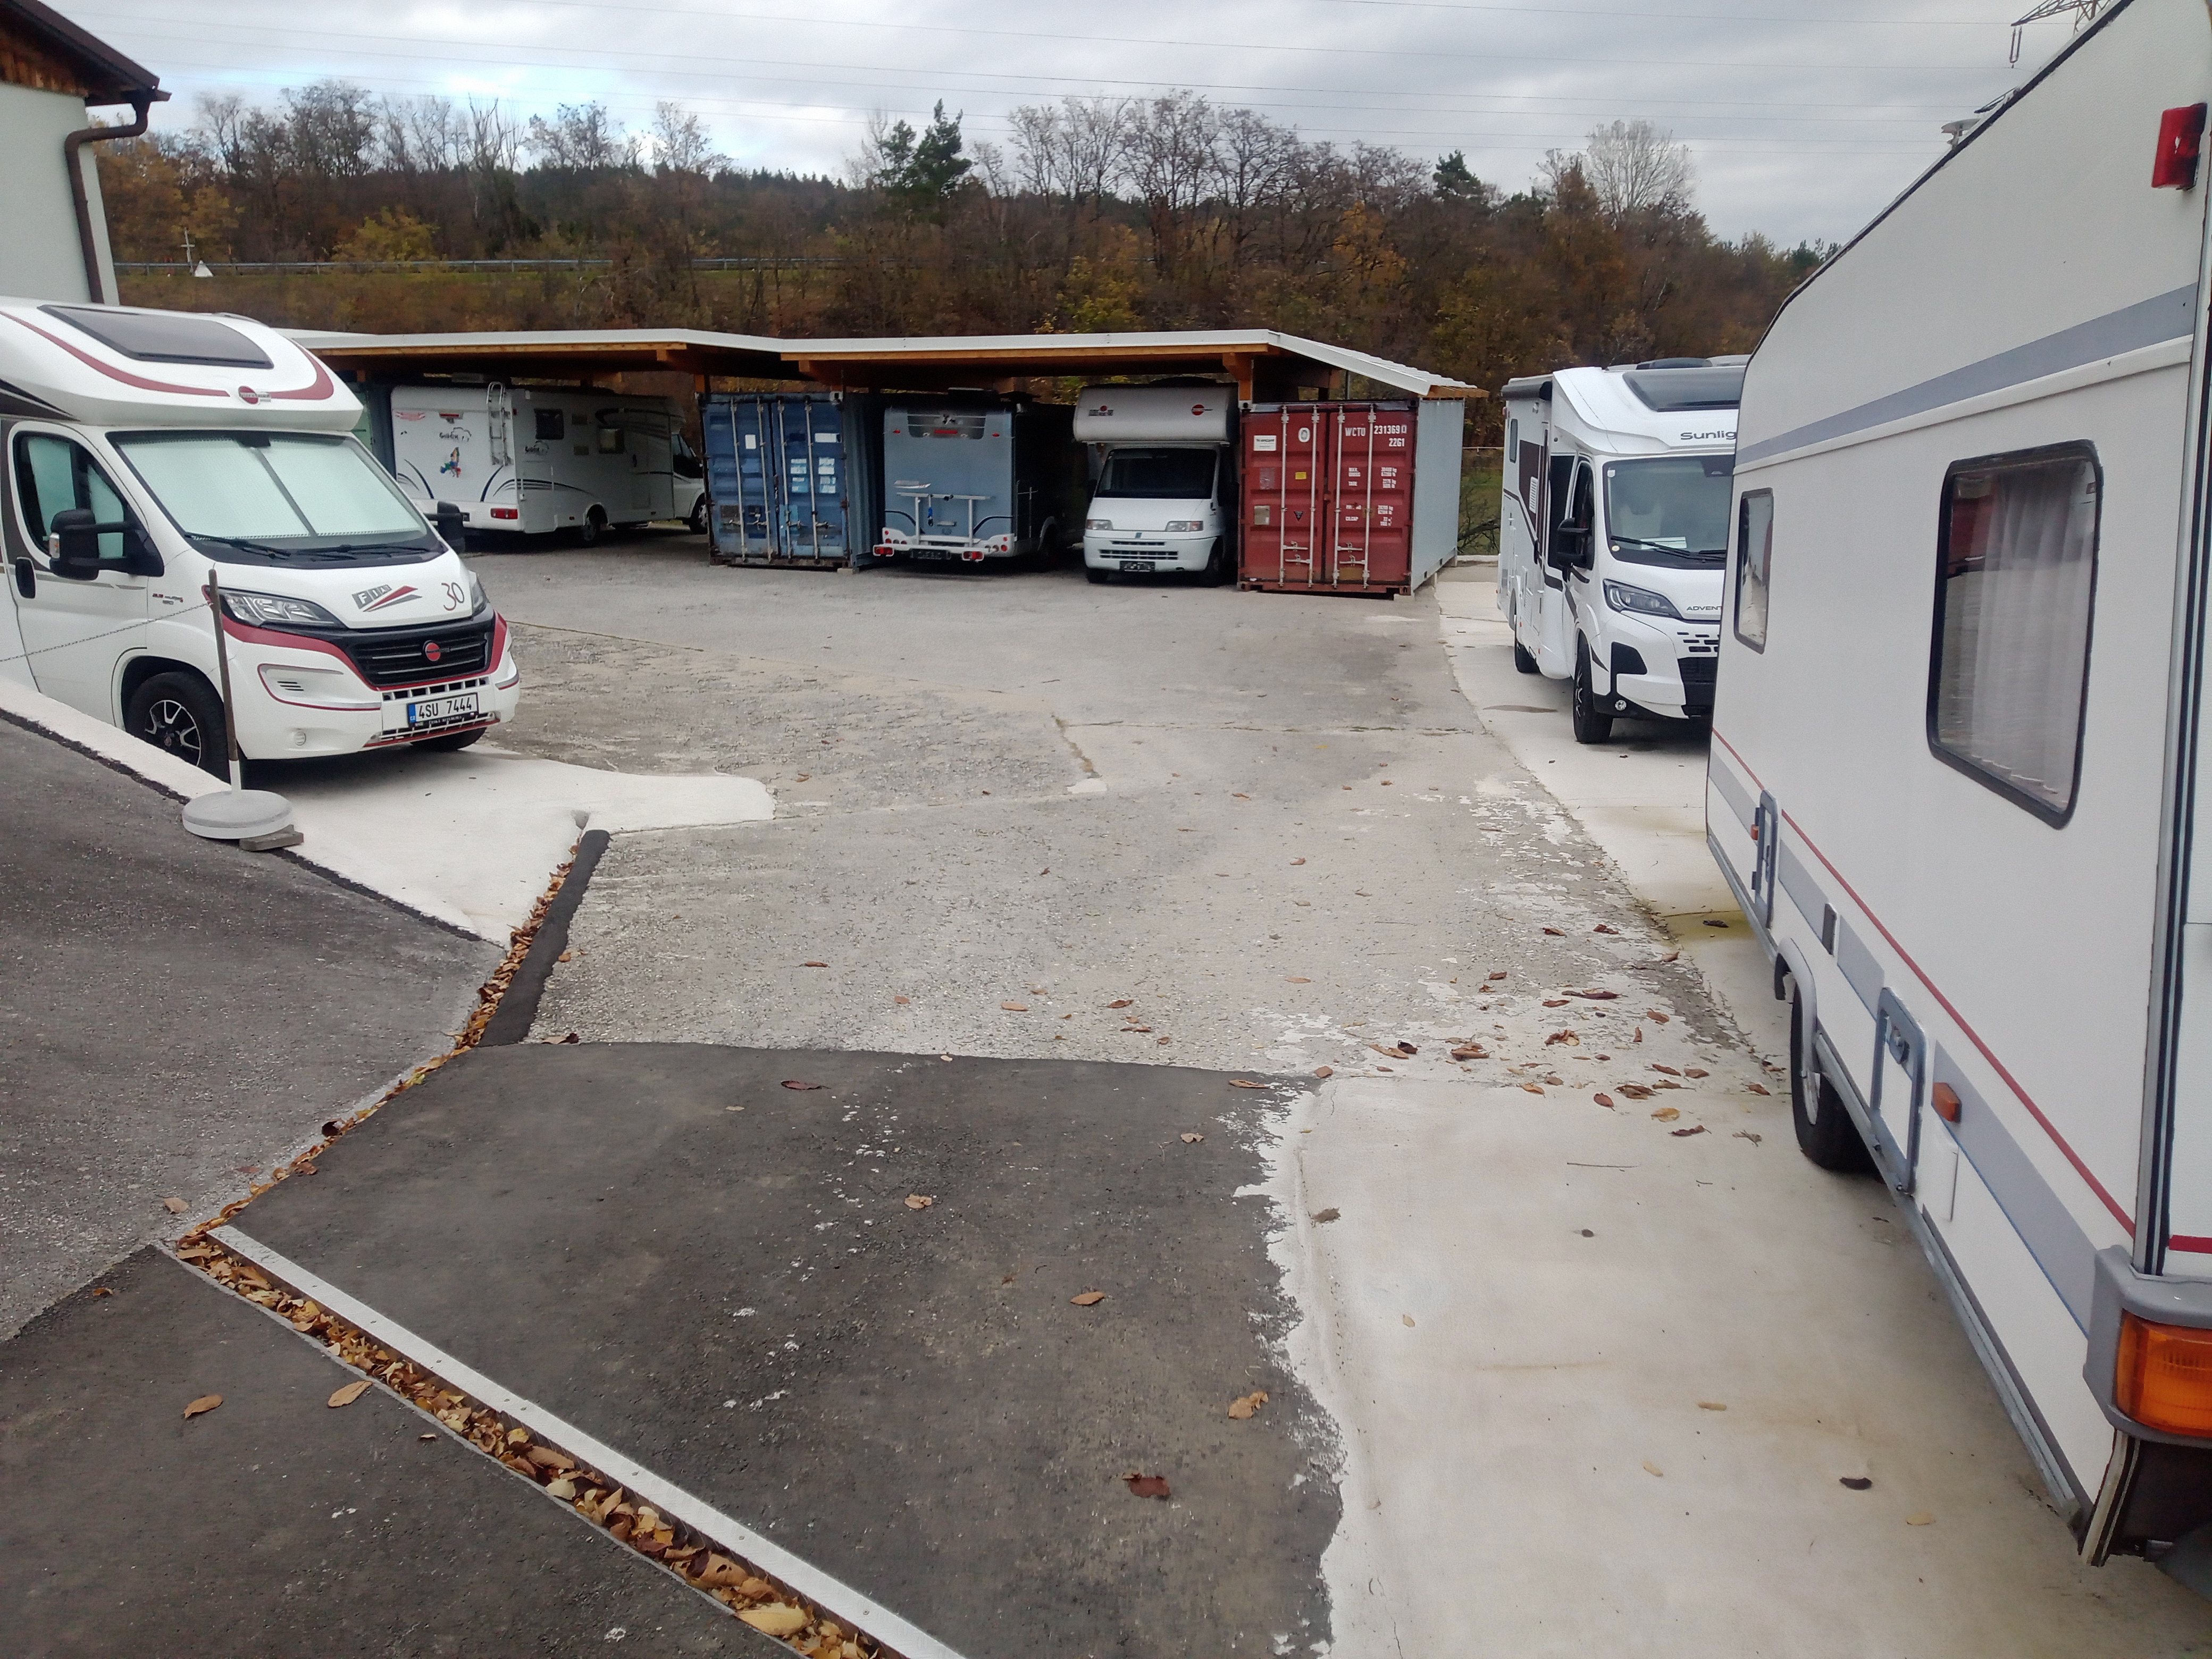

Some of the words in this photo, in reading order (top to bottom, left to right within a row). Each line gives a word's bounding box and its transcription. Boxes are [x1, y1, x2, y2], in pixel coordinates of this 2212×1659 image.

[1345, 427, 1366, 437] WCTU
[1680, 430, 1737, 440] Sunlig
[1388, 438, 1405, 447] 22G1
[440, 582, 465, 611] 30
[418, 702, 439, 719] 4SU
[447, 697, 472, 714] 7444
